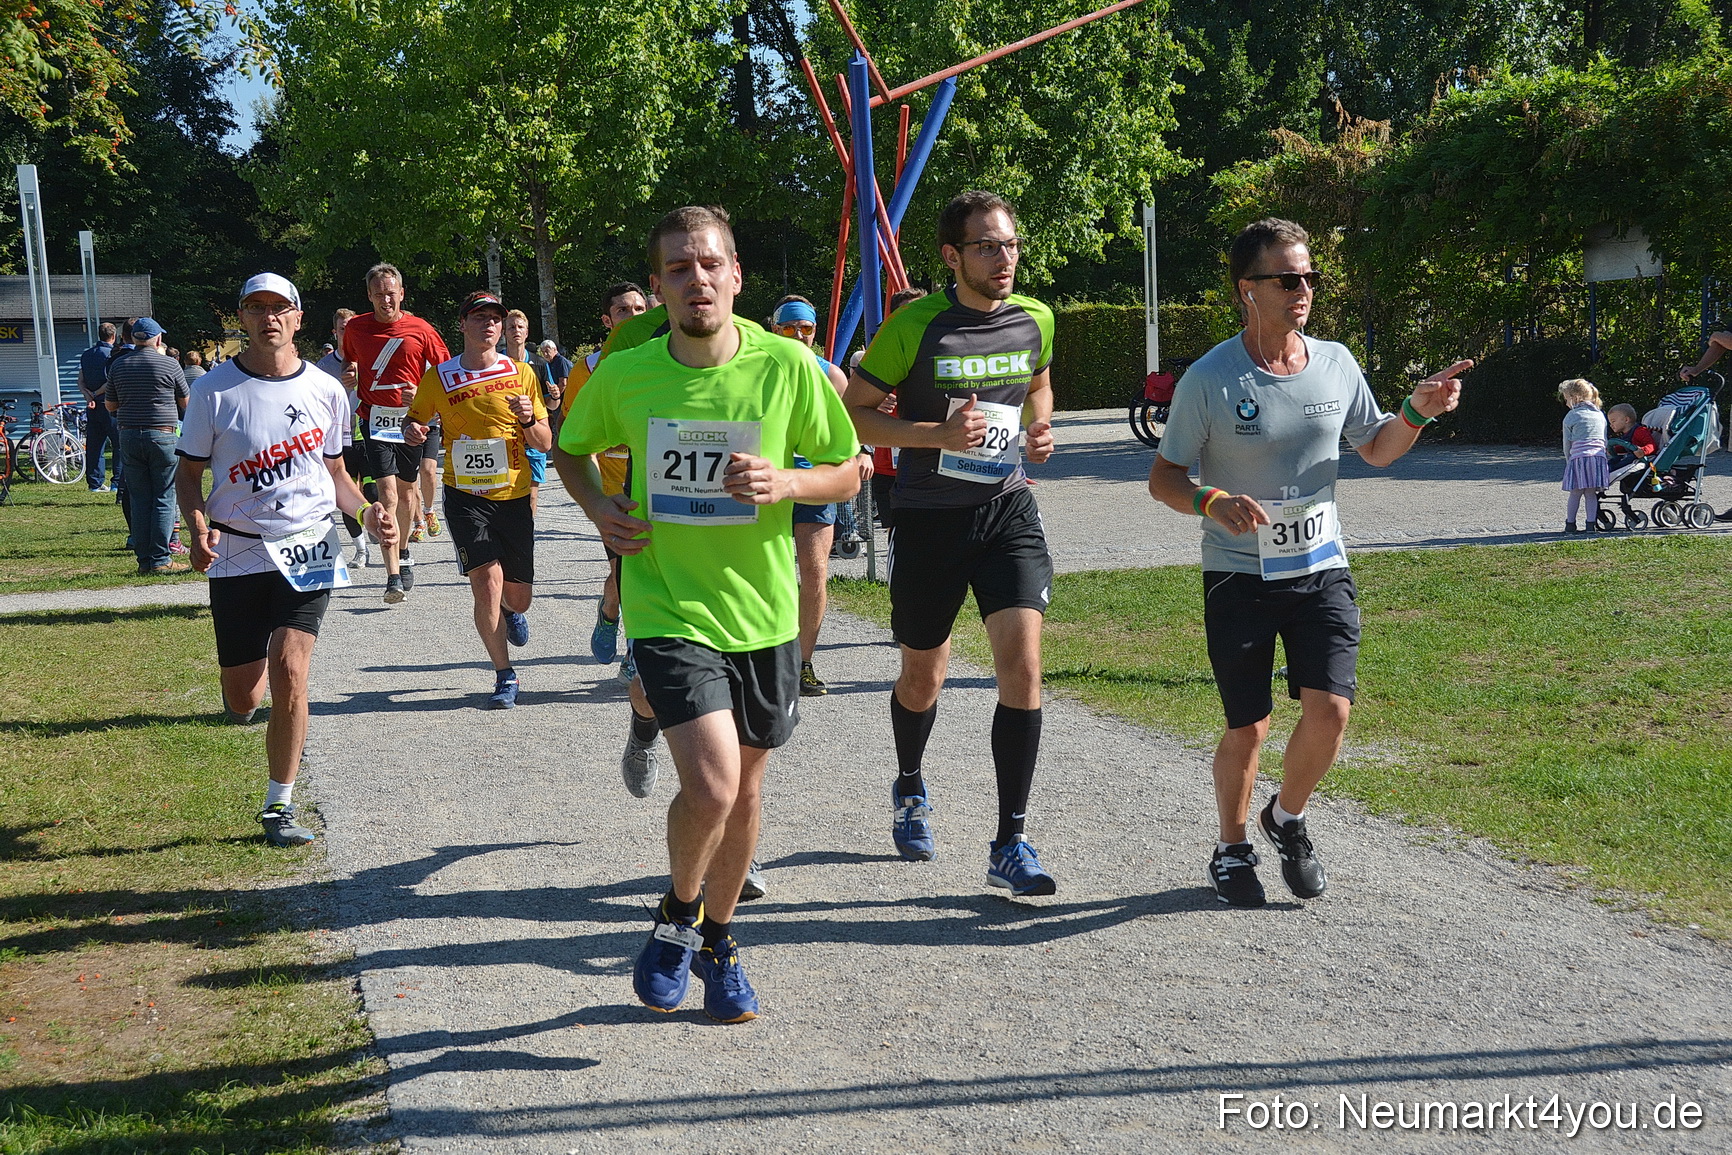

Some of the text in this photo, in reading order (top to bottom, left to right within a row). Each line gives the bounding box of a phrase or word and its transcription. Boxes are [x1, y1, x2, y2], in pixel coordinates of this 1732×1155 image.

[935, 350, 1032, 379] BOCK
[448, 379, 523, 406] MAX BÖGL
[935, 381, 969, 390] inspired
[970, 380, 981, 389] by
[982, 378, 1005, 387] smart
[1304, 400, 1341, 416] BOCK
[375, 416, 404, 428] 2615
[679, 430, 728, 442] BOCK
[976, 426, 1009, 452] 28
[229, 427, 324, 484] FINISHER
[464, 453, 495, 469] 255
[663, 450, 738, 482] 217
[957, 459, 1003, 476] Sebastian
[245, 457, 293, 493] 2017
[471, 477, 493, 485] Simon
[671, 485, 693, 493] PARTL
[690, 501, 715, 514] Udo
[1283, 499, 1317, 516] BOCK
[1272, 511, 1324, 546] 3107
[280, 540, 333, 567] 3072
